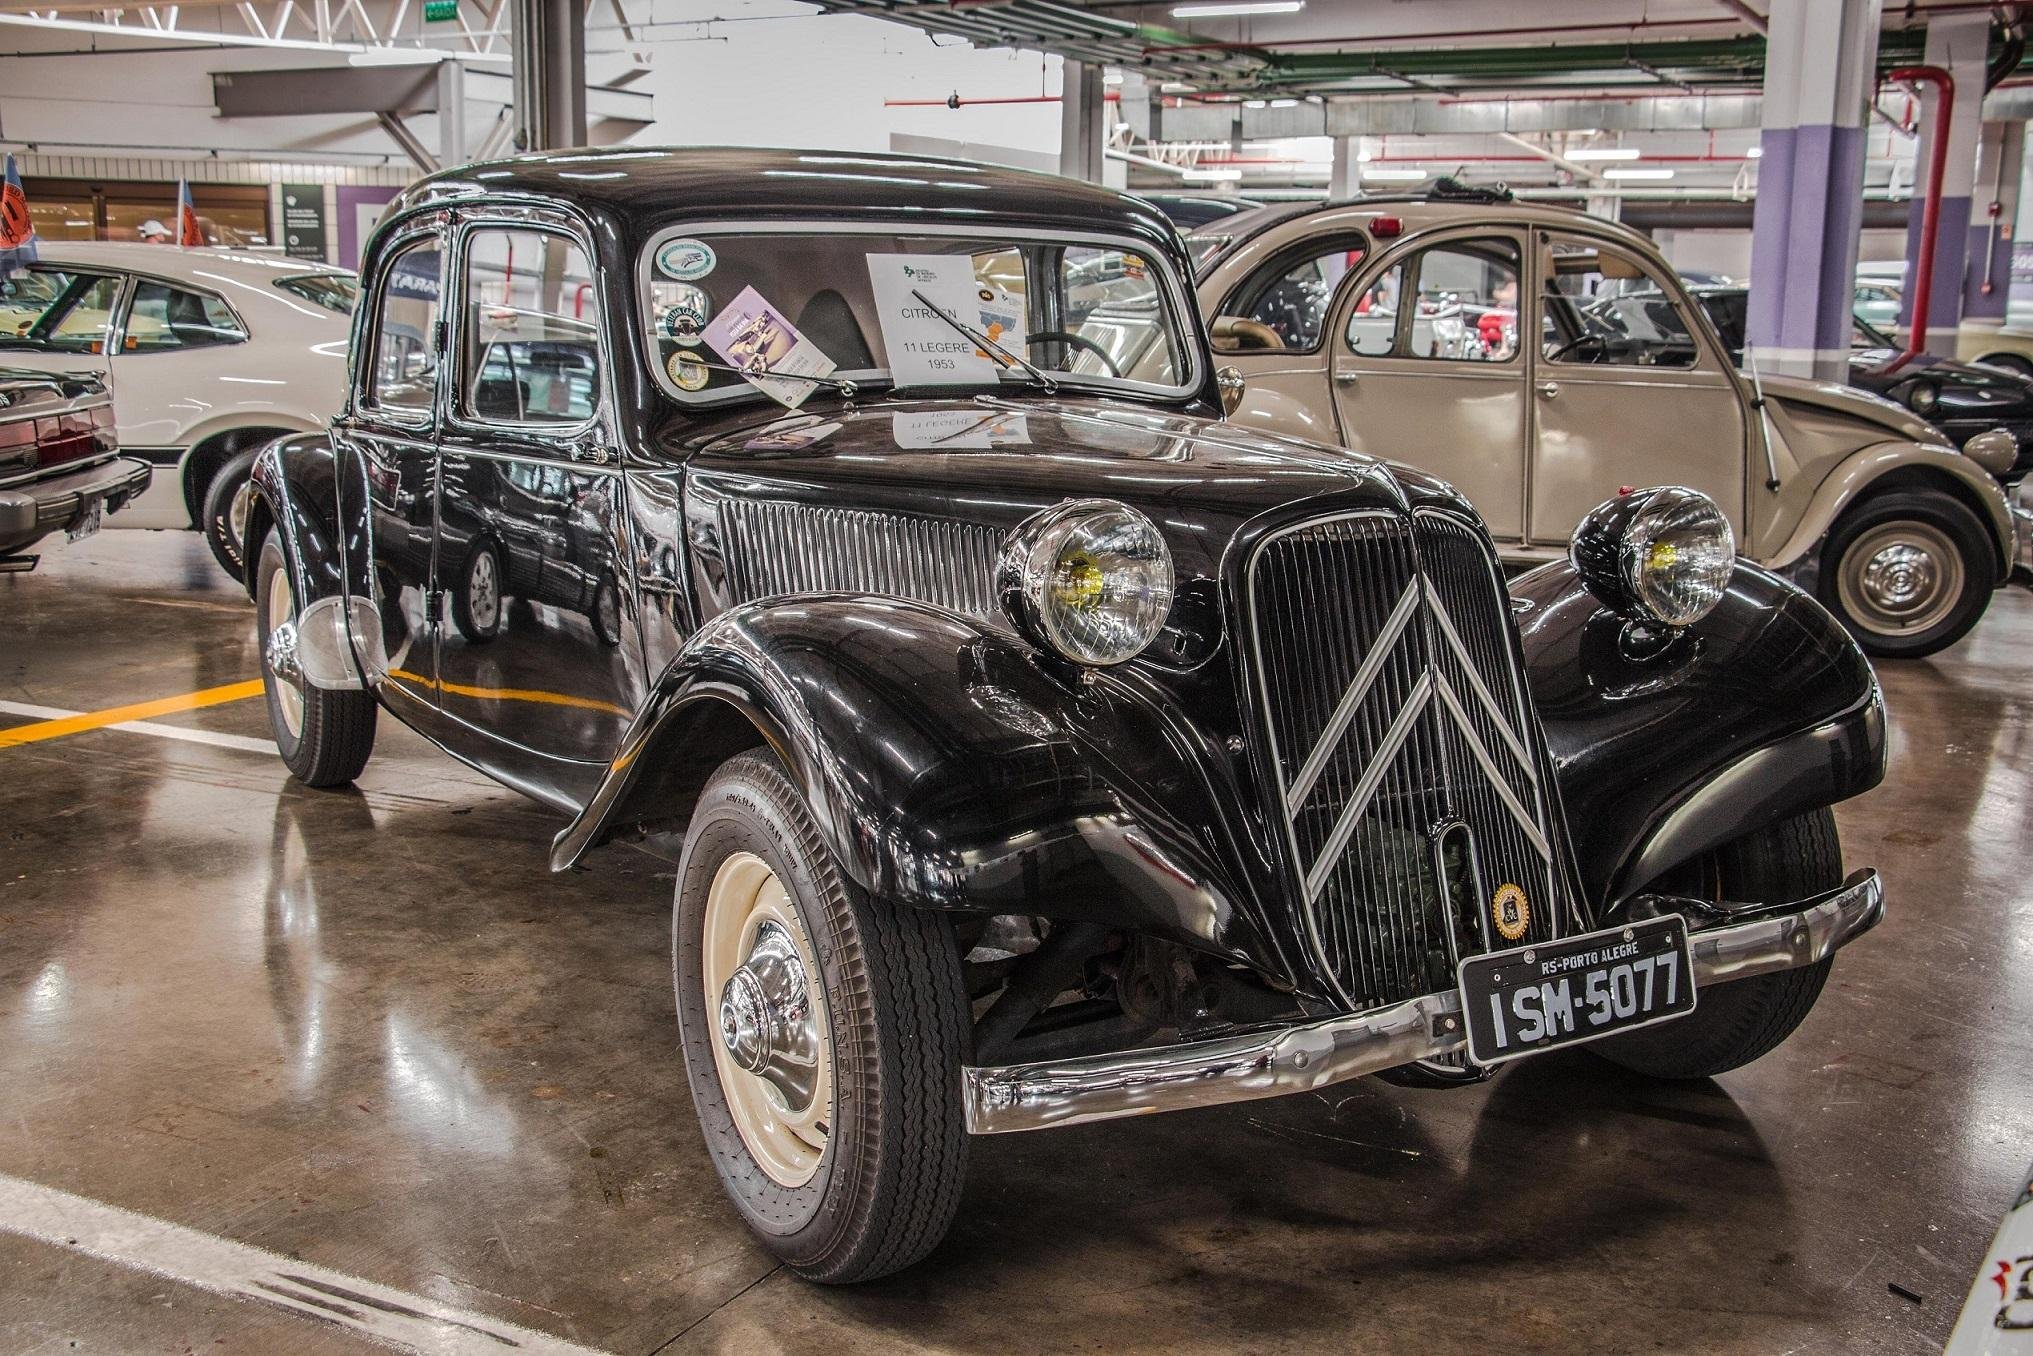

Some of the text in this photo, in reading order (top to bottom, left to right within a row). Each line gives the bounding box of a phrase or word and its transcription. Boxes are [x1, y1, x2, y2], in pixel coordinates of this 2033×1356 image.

[901, 307, 957, 319] CITRON
[903, 342, 971, 354] 11 LEGERE
[927, 359, 955, 369] 1953
[1541, 941, 1639, 976] RS-PORTO ALEGRE
